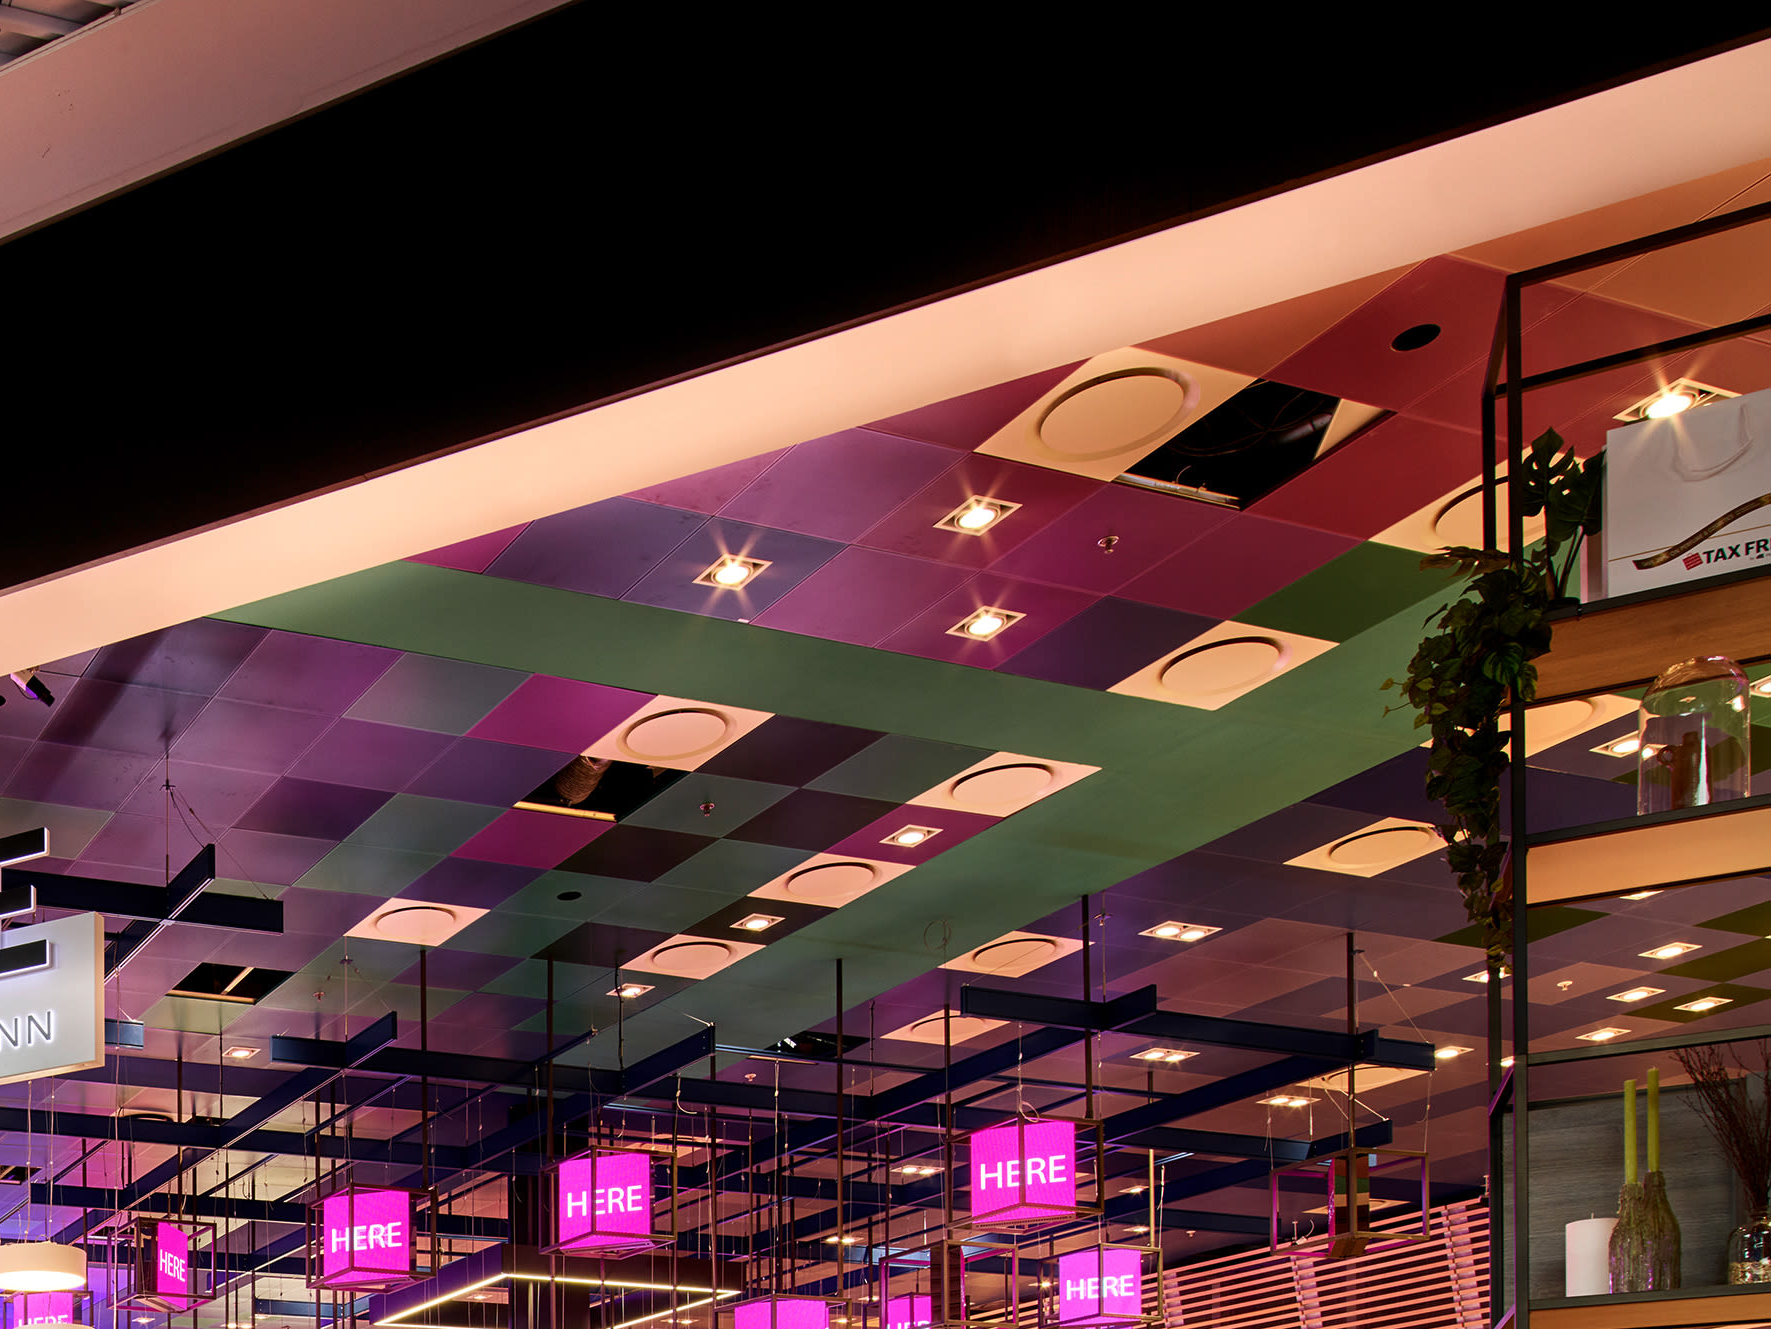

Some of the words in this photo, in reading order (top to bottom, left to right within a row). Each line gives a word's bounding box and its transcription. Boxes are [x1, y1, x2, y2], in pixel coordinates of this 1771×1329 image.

[1702, 544, 1741, 564] TAX
[1744, 537, 1771, 556] FR
[979, 1155, 1067, 1190] HERE
[566, 1184, 643, 1218] HERE
[331, 1221, 403, 1254] HERE
[159, 1249, 186, 1282] HERE
[1065, 1274, 1135, 1301] HERE
